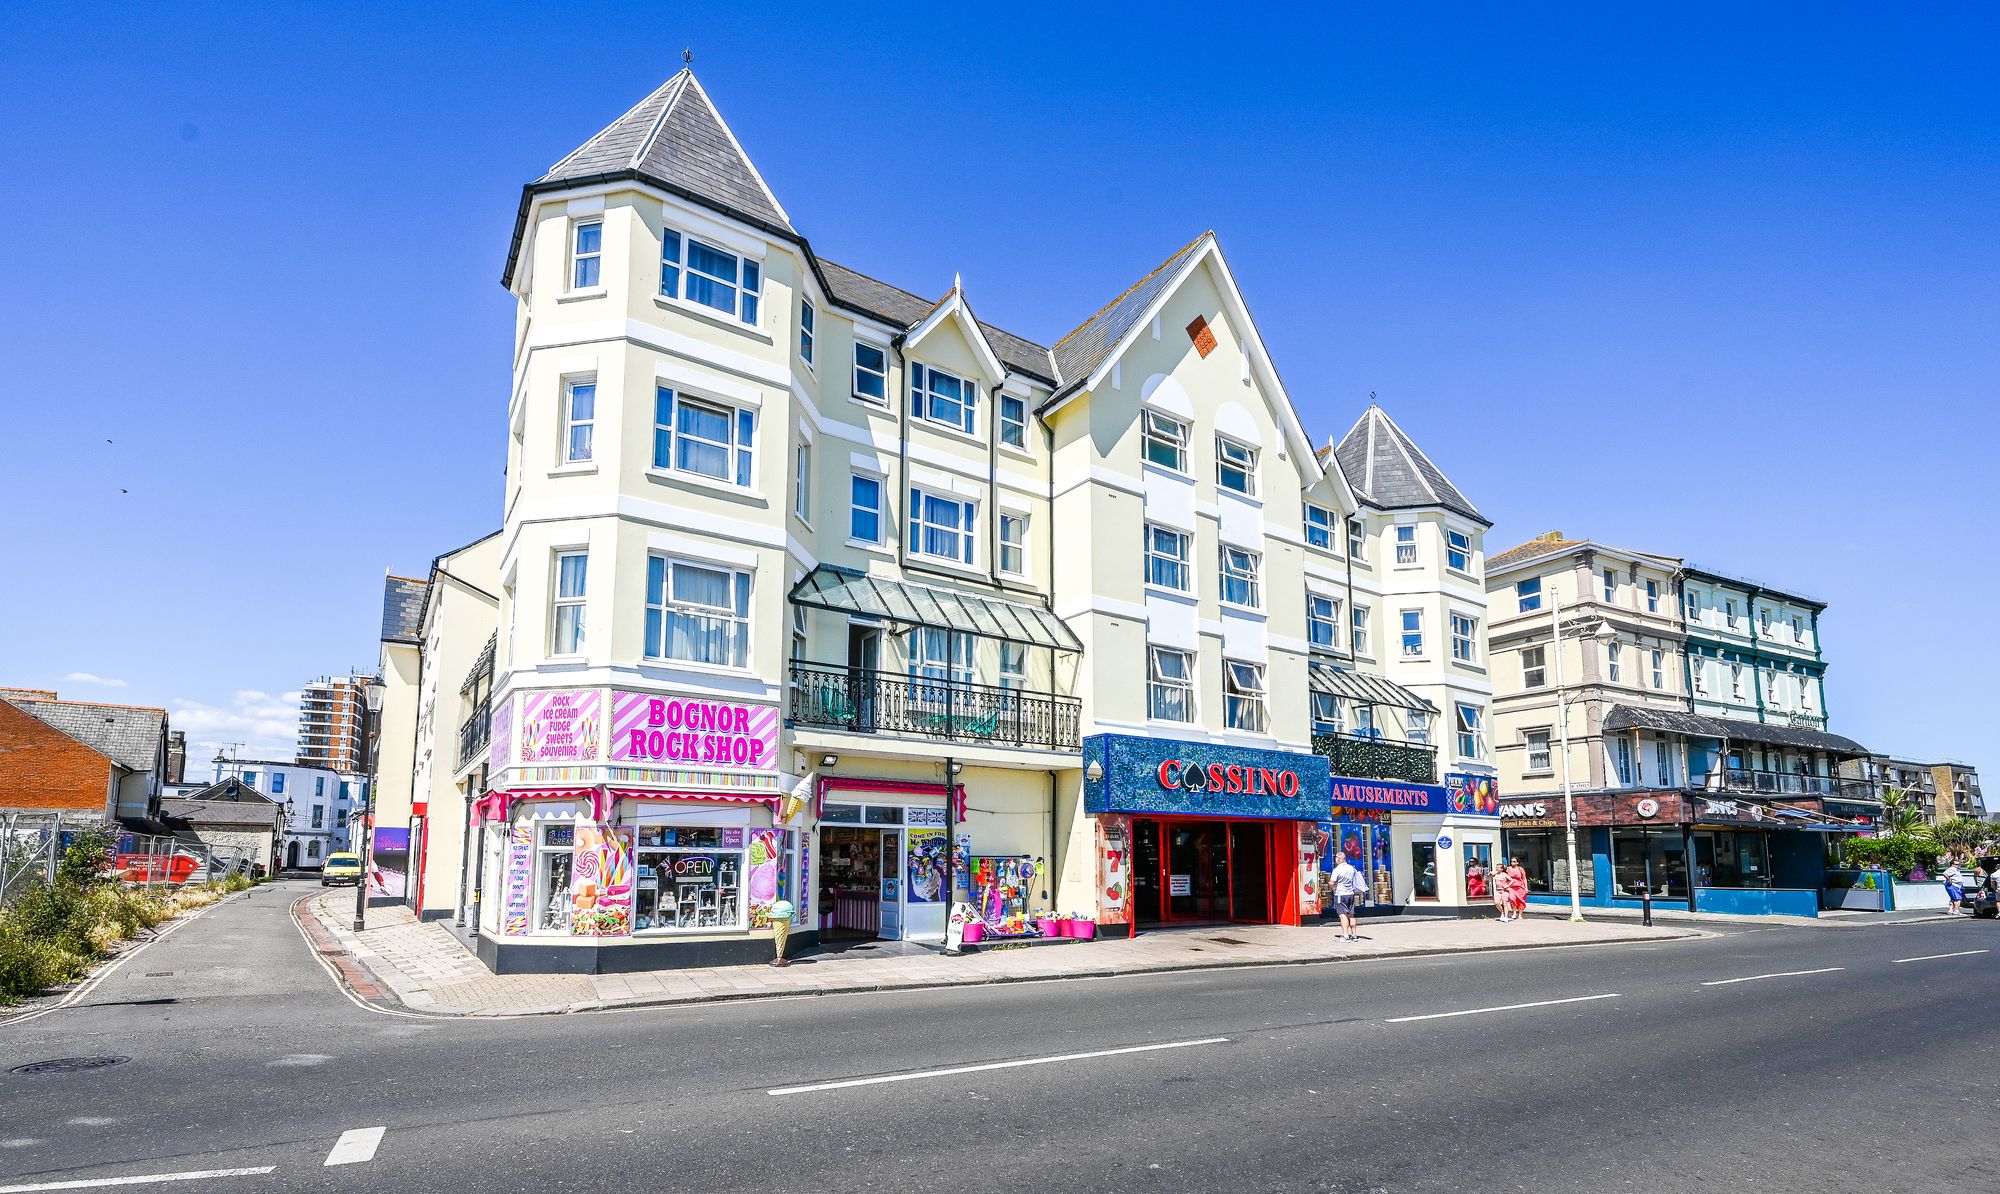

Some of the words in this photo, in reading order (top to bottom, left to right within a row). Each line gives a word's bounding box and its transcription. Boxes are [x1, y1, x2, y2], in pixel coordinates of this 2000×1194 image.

[552, 695, 570, 707] ROCK
[648, 699, 750, 735] BOGNOR
[549, 720, 571, 732] FUDGE
[540, 745, 578, 757] SOUVENIRS
[629, 728, 699, 762] ROCK
[703, 734, 764, 765] SHOP
[1331, 783, 1429, 807] AMUSEMENTS
[1518, 819, 1532, 827] Fish
[1538, 819, 1557, 828] Chips
[725, 836, 740, 844] Open
[674, 860, 713, 874] OPEN
